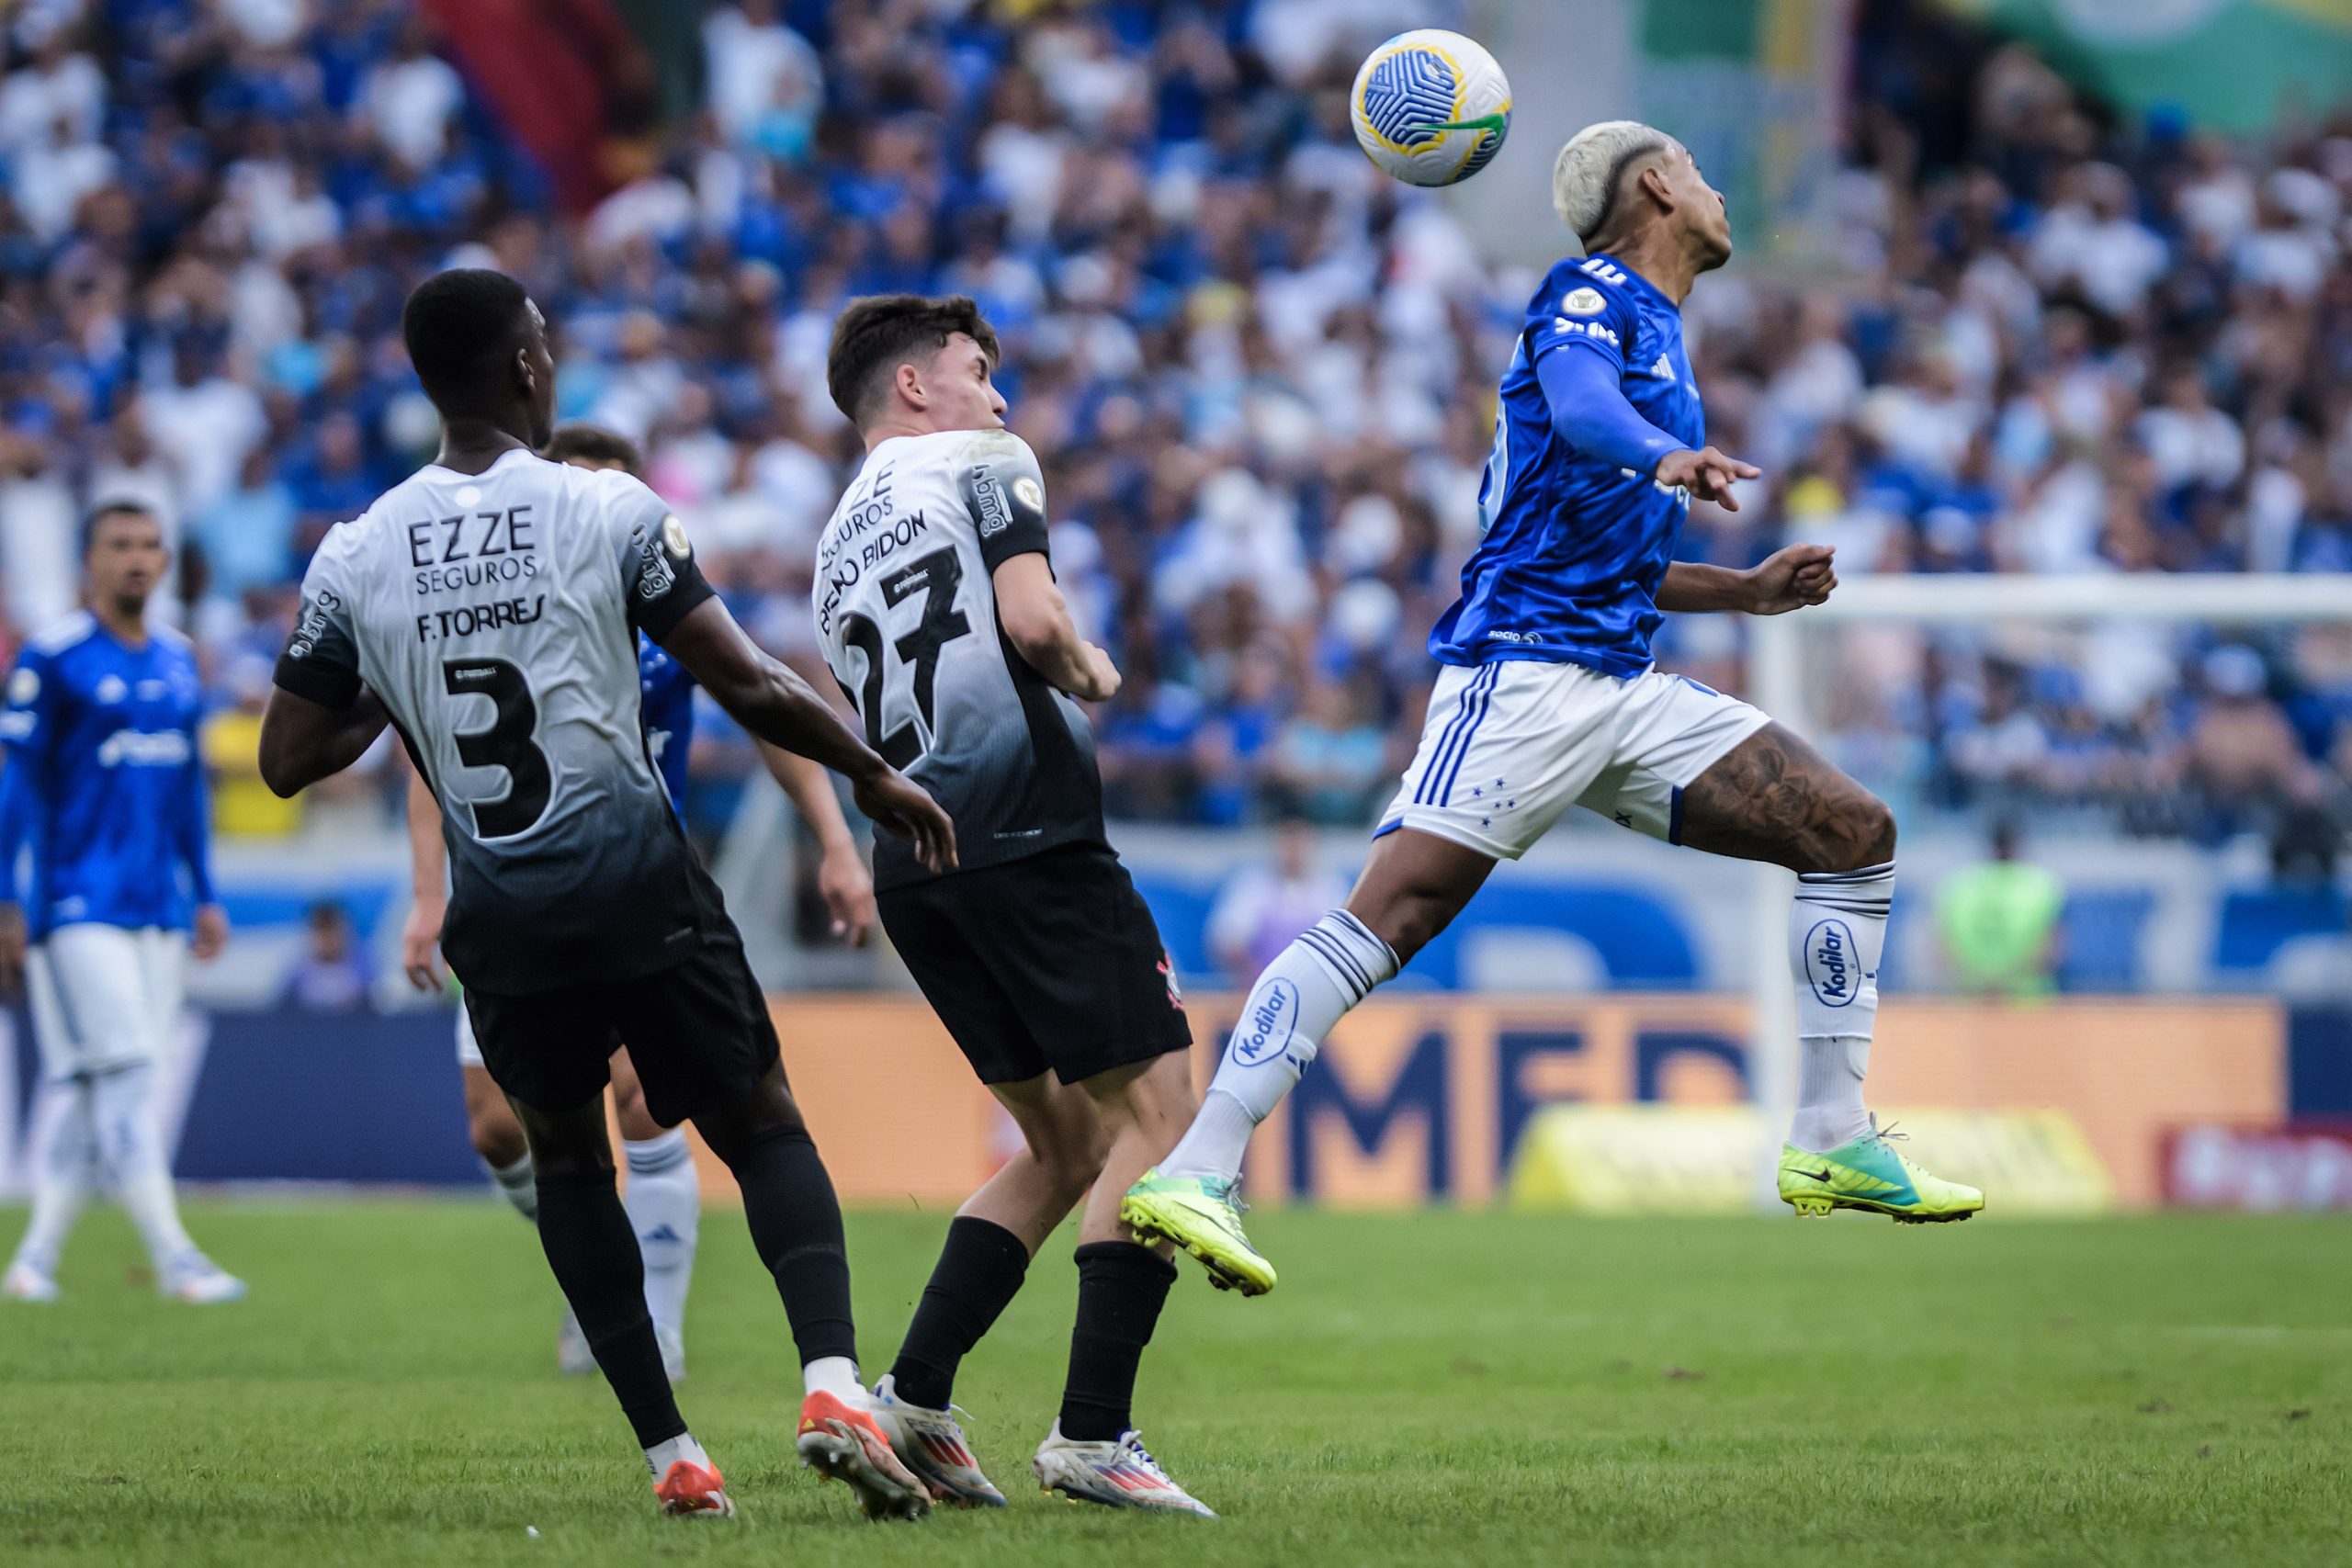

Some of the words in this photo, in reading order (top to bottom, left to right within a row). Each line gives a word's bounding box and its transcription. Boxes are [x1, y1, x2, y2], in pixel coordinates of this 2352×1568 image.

[408, 504, 535, 567] EZZE
[862, 508, 927, 571] BIDON
[415, 556, 537, 595] SEGUROS
[417, 594, 546, 643] F.TORRES
[837, 544, 971, 773] 27
[443, 657, 552, 838] 3
[1818, 925, 1847, 998] Kodilar
[1239, 984, 1286, 1059] Kodilar
